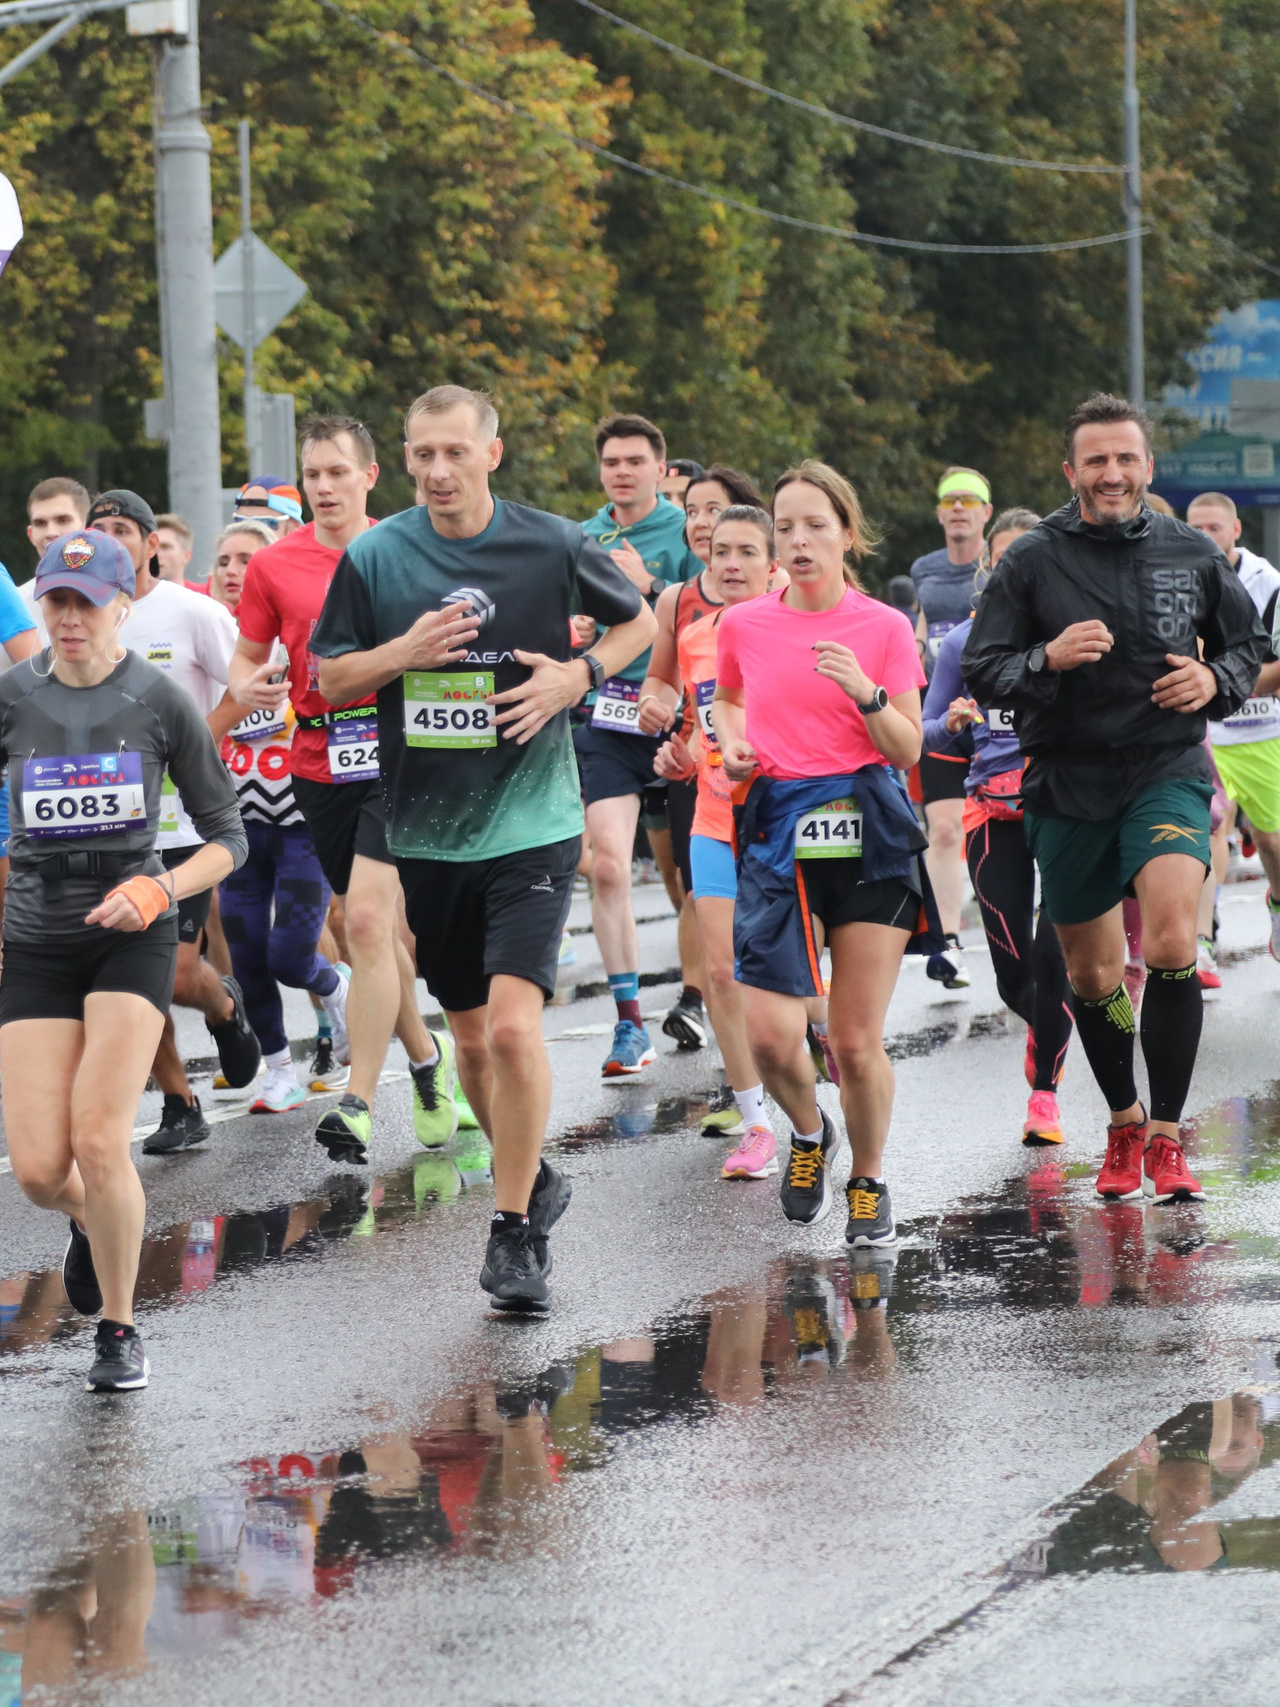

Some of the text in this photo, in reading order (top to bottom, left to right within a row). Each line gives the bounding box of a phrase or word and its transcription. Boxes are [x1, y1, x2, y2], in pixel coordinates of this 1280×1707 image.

[333, 706, 378, 722] POWER
[413, 707, 490, 731] 4508
[601, 702, 639, 721] 569
[338, 746, 380, 768] 624
[35, 793, 121, 821] 6083
[802, 819, 860, 840] 4141
